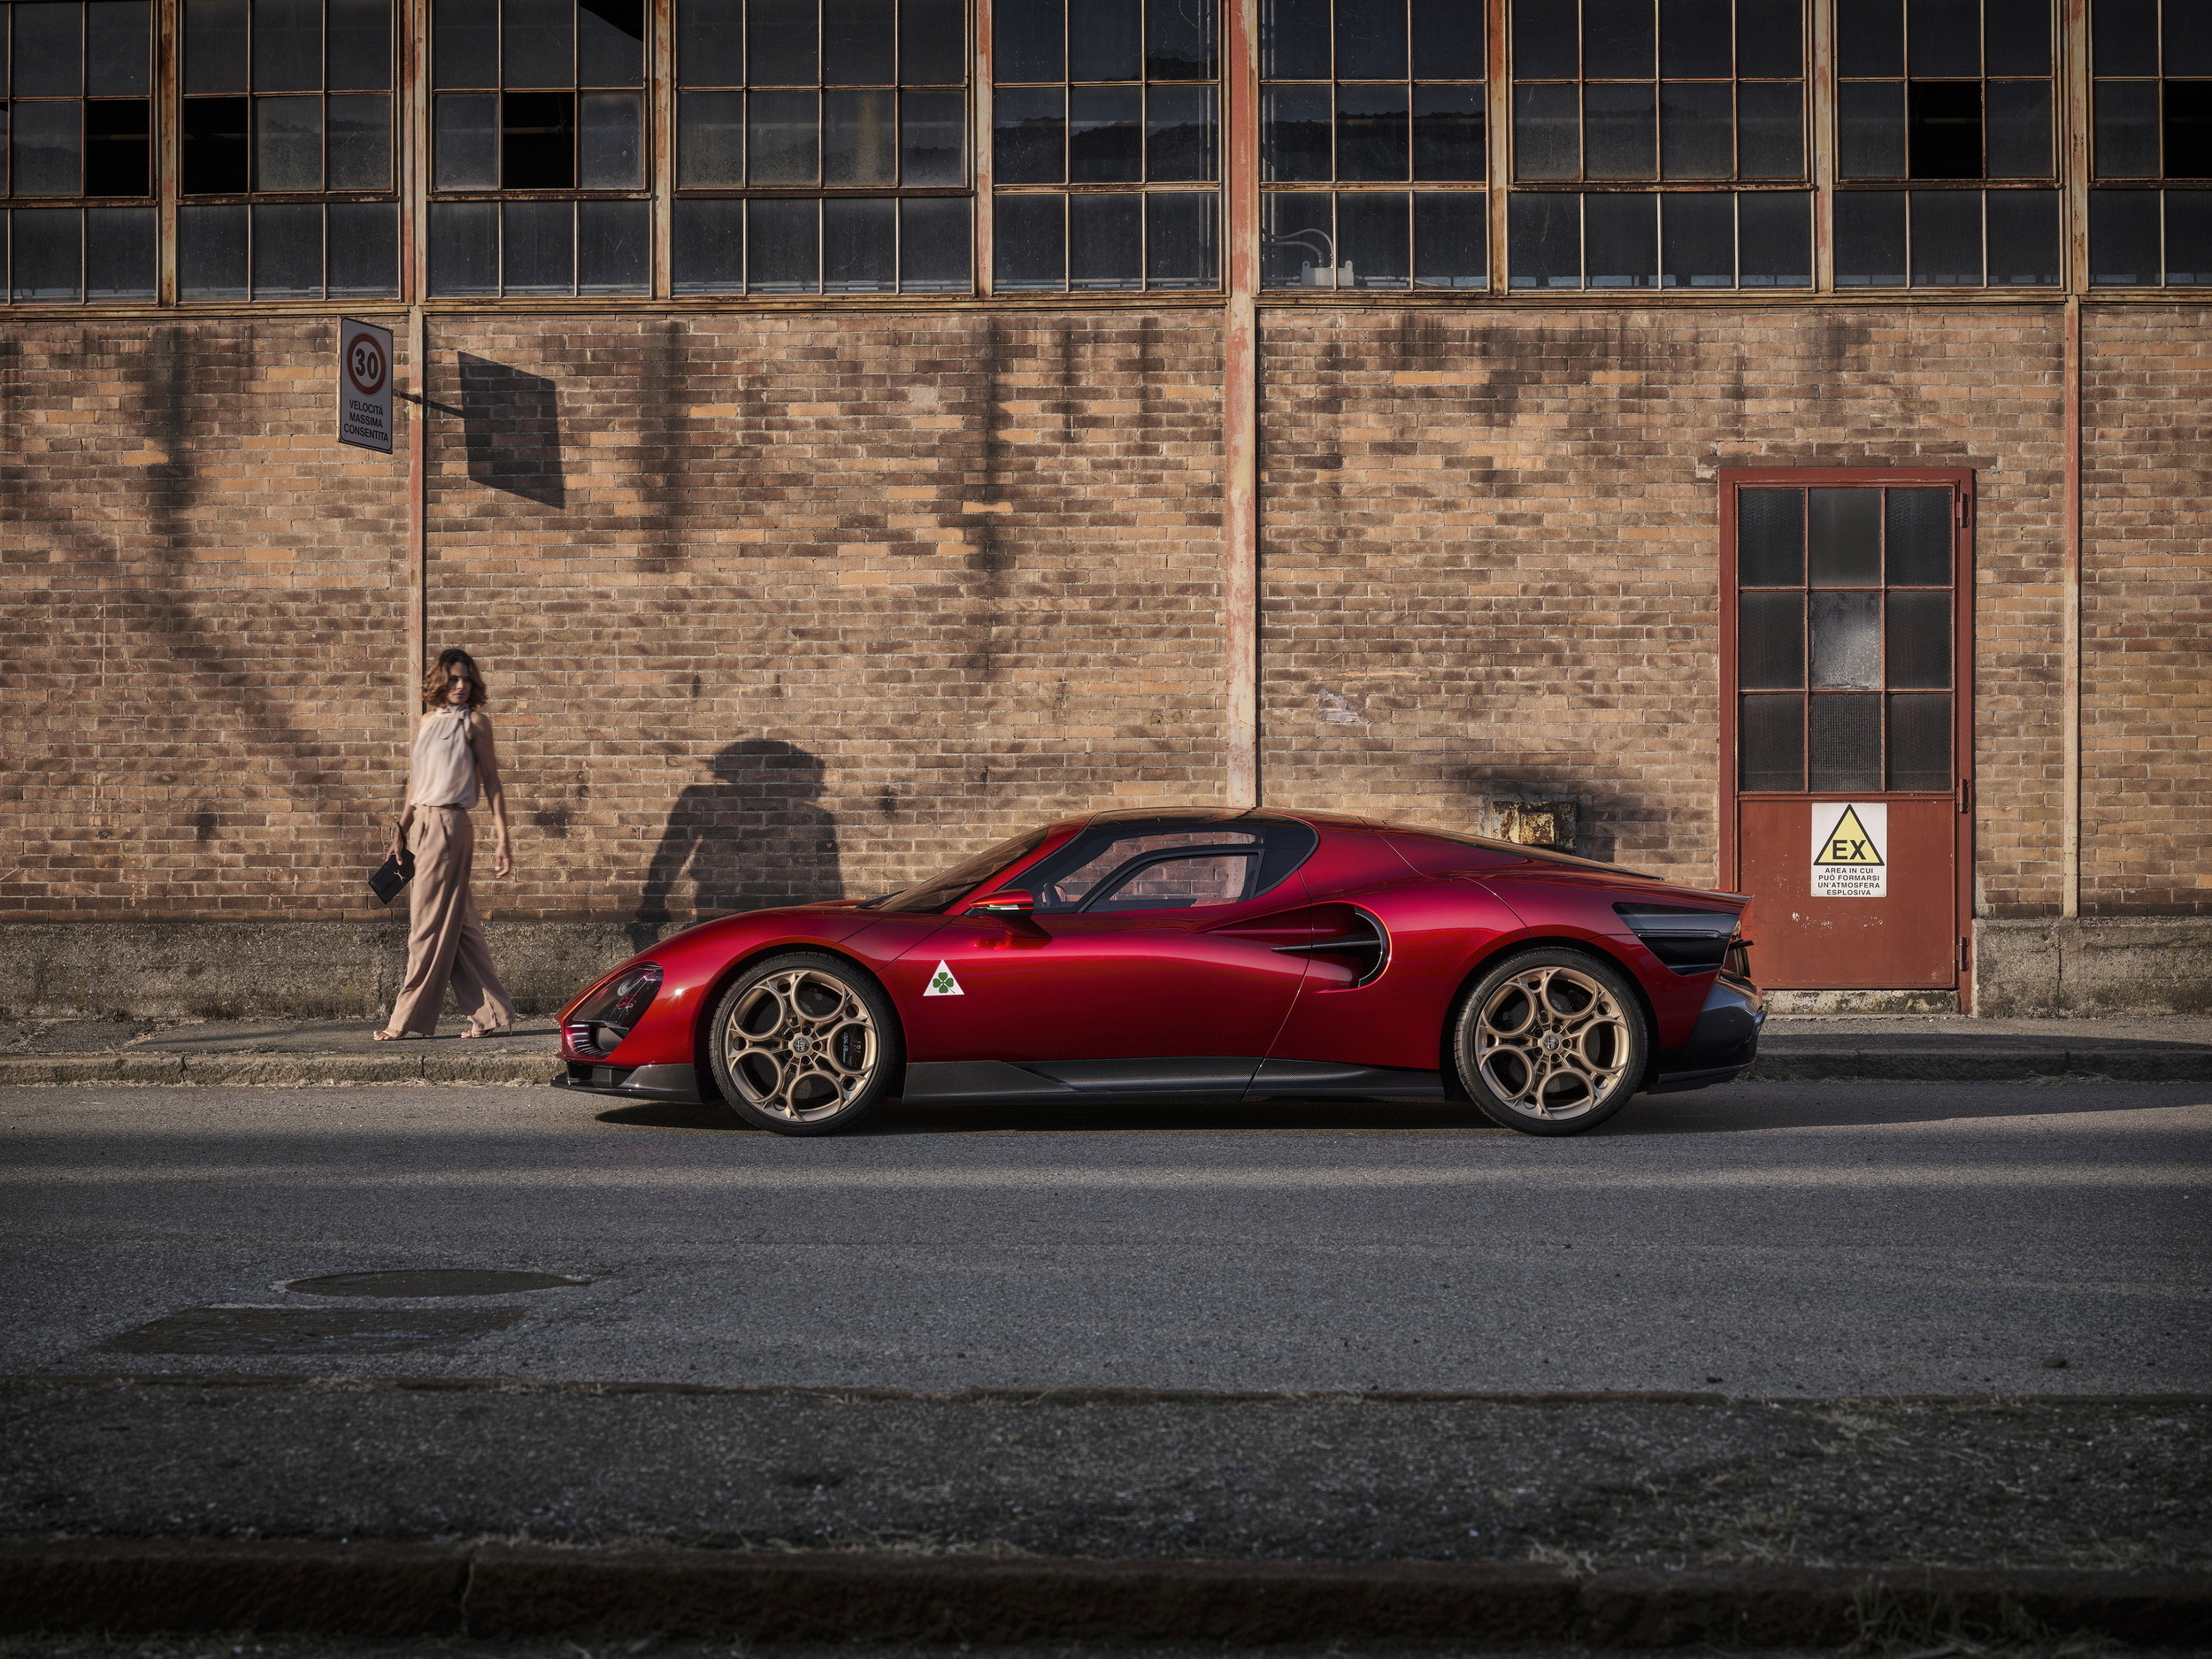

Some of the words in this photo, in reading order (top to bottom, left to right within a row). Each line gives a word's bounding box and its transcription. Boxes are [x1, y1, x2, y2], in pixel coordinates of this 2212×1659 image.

[356, 349, 378, 380] 30
[349, 412, 383, 429] MASSIMA
[343, 423, 389, 442] CONSENTITA
[1832, 840, 1866, 860] EX
